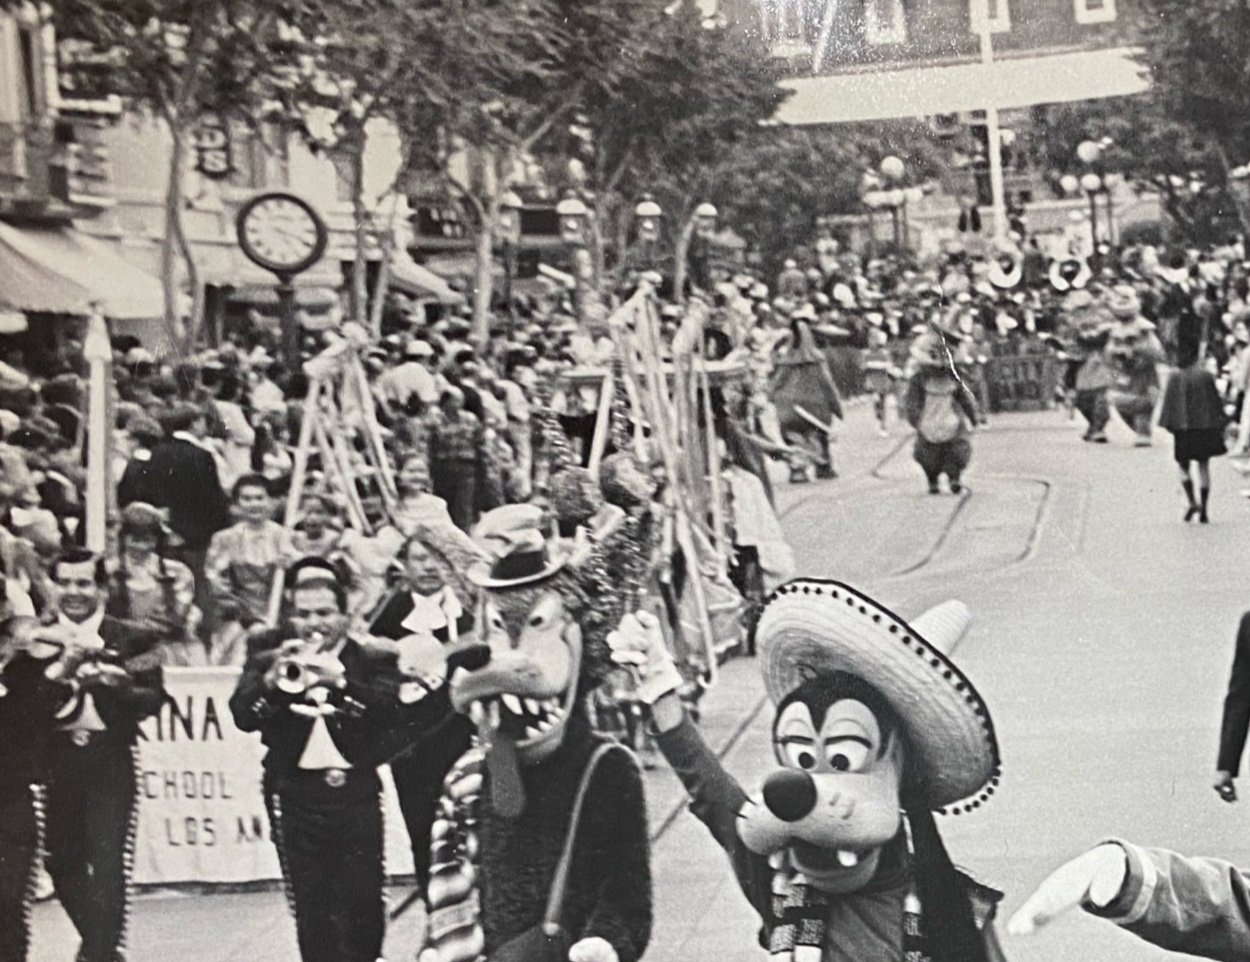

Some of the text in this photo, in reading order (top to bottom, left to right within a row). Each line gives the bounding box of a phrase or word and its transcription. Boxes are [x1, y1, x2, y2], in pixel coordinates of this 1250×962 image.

[136, 694, 224, 742] INA
[142, 771, 233, 799] CHOOL
[165, 816, 216, 847] LOS
